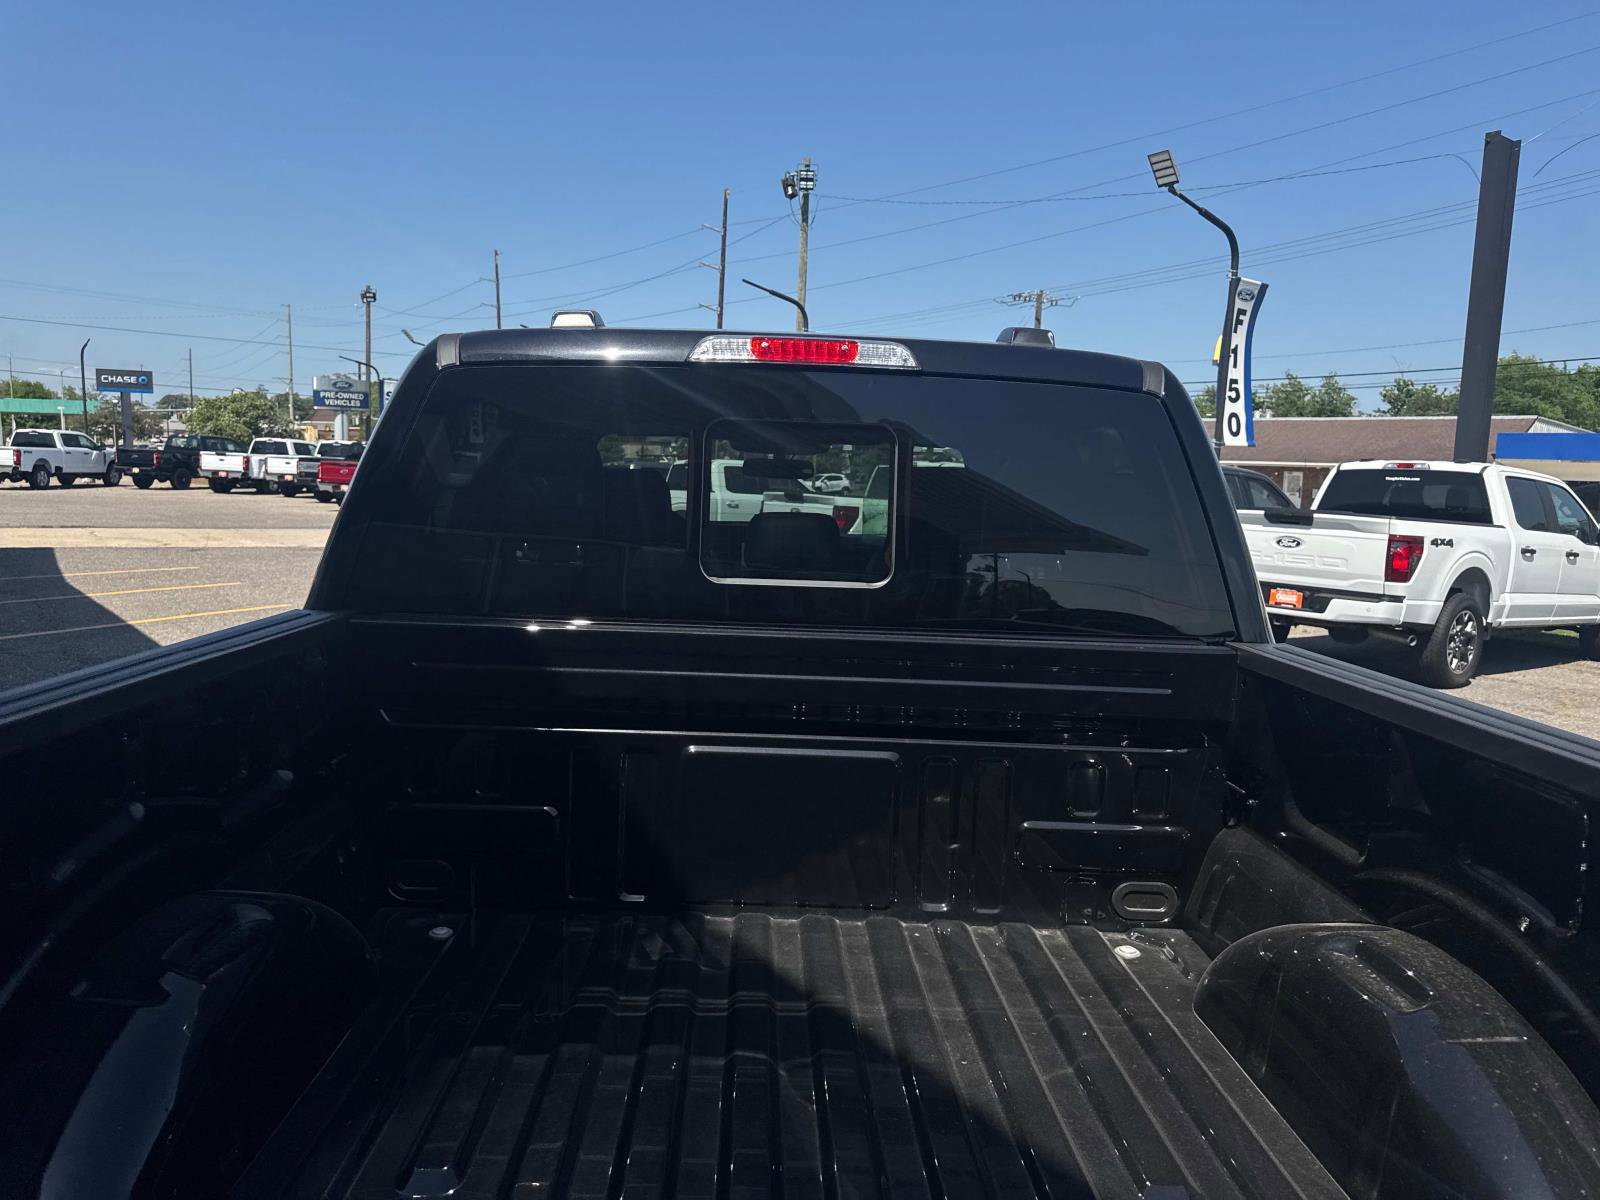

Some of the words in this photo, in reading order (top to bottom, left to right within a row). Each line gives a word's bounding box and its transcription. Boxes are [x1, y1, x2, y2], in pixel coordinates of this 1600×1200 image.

[101, 375, 138, 384] CHASE
[320, 391, 364, 400] PRE-OWNED
[1279, 537, 1299, 547] Ford
